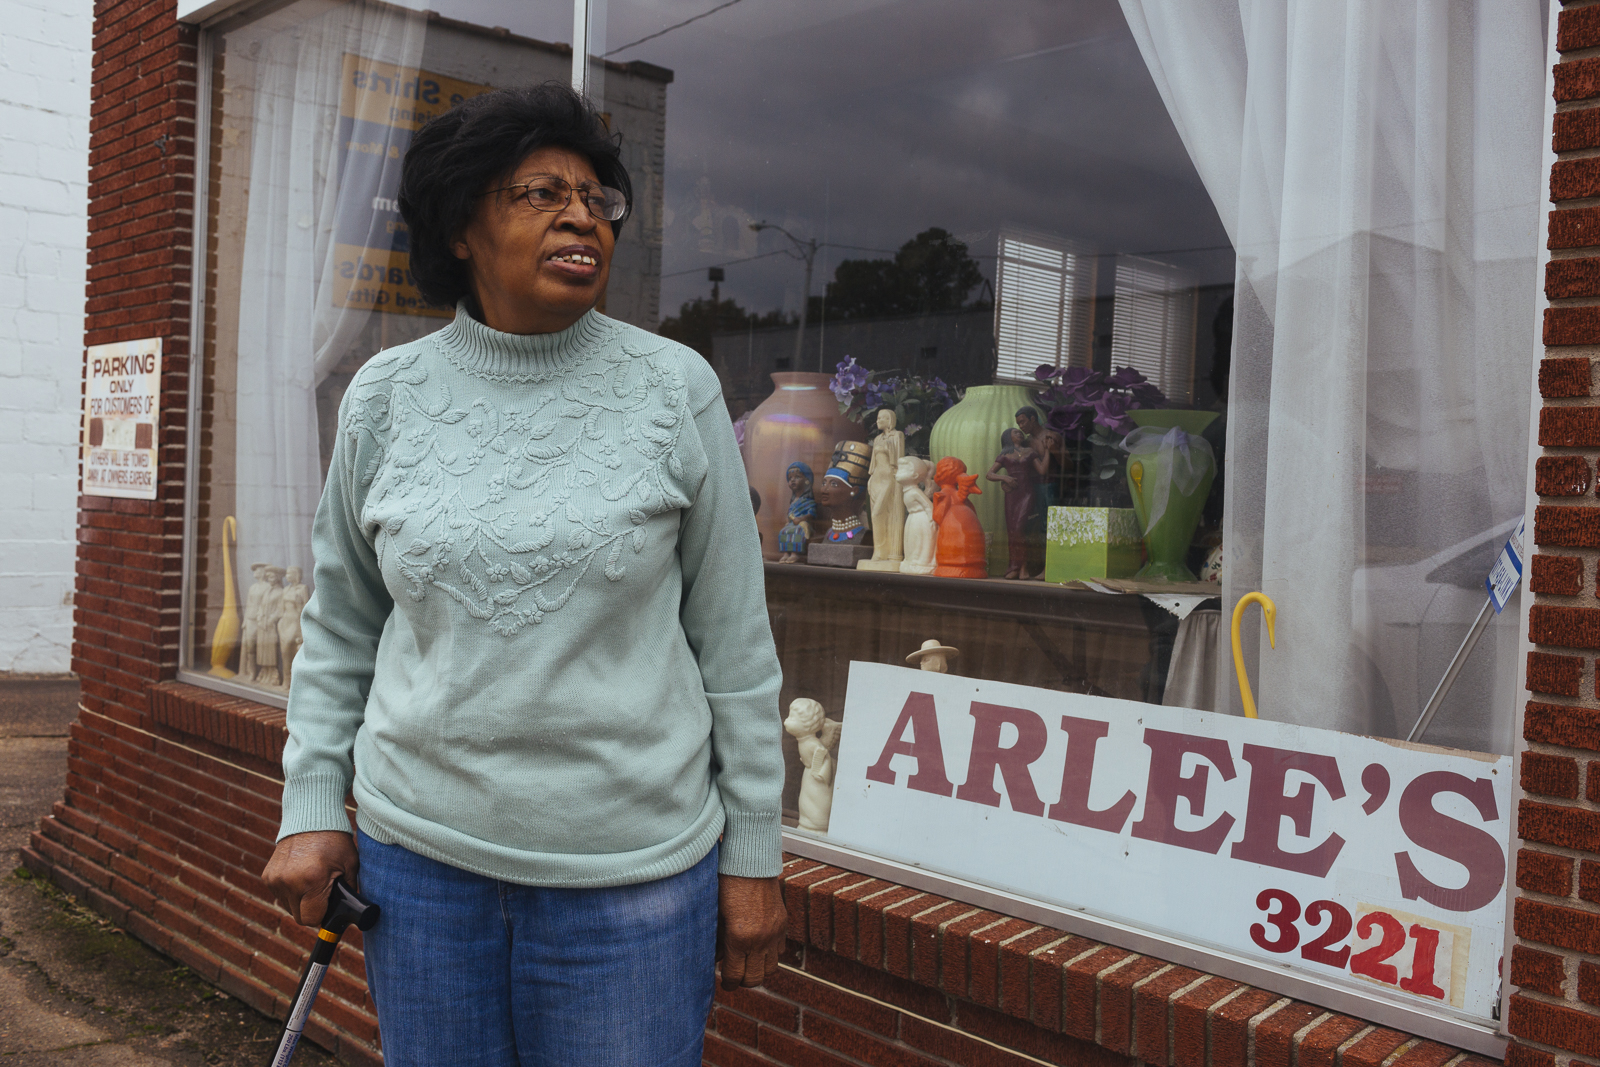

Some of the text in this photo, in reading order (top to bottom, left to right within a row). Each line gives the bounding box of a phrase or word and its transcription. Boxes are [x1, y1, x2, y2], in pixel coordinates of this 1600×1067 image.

[93, 354, 155, 378] PARKING
[109, 379, 134, 393] ONLY
[91, 395, 154, 415] FOR CUSTOMERS OF
[91, 451, 149, 467] OTHERS WILL BE TOWED
[129, 470, 152, 485] EXPENSE
[865, 690, 1506, 912] ARLEE'S
[1249, 888, 1446, 1000] 3221
